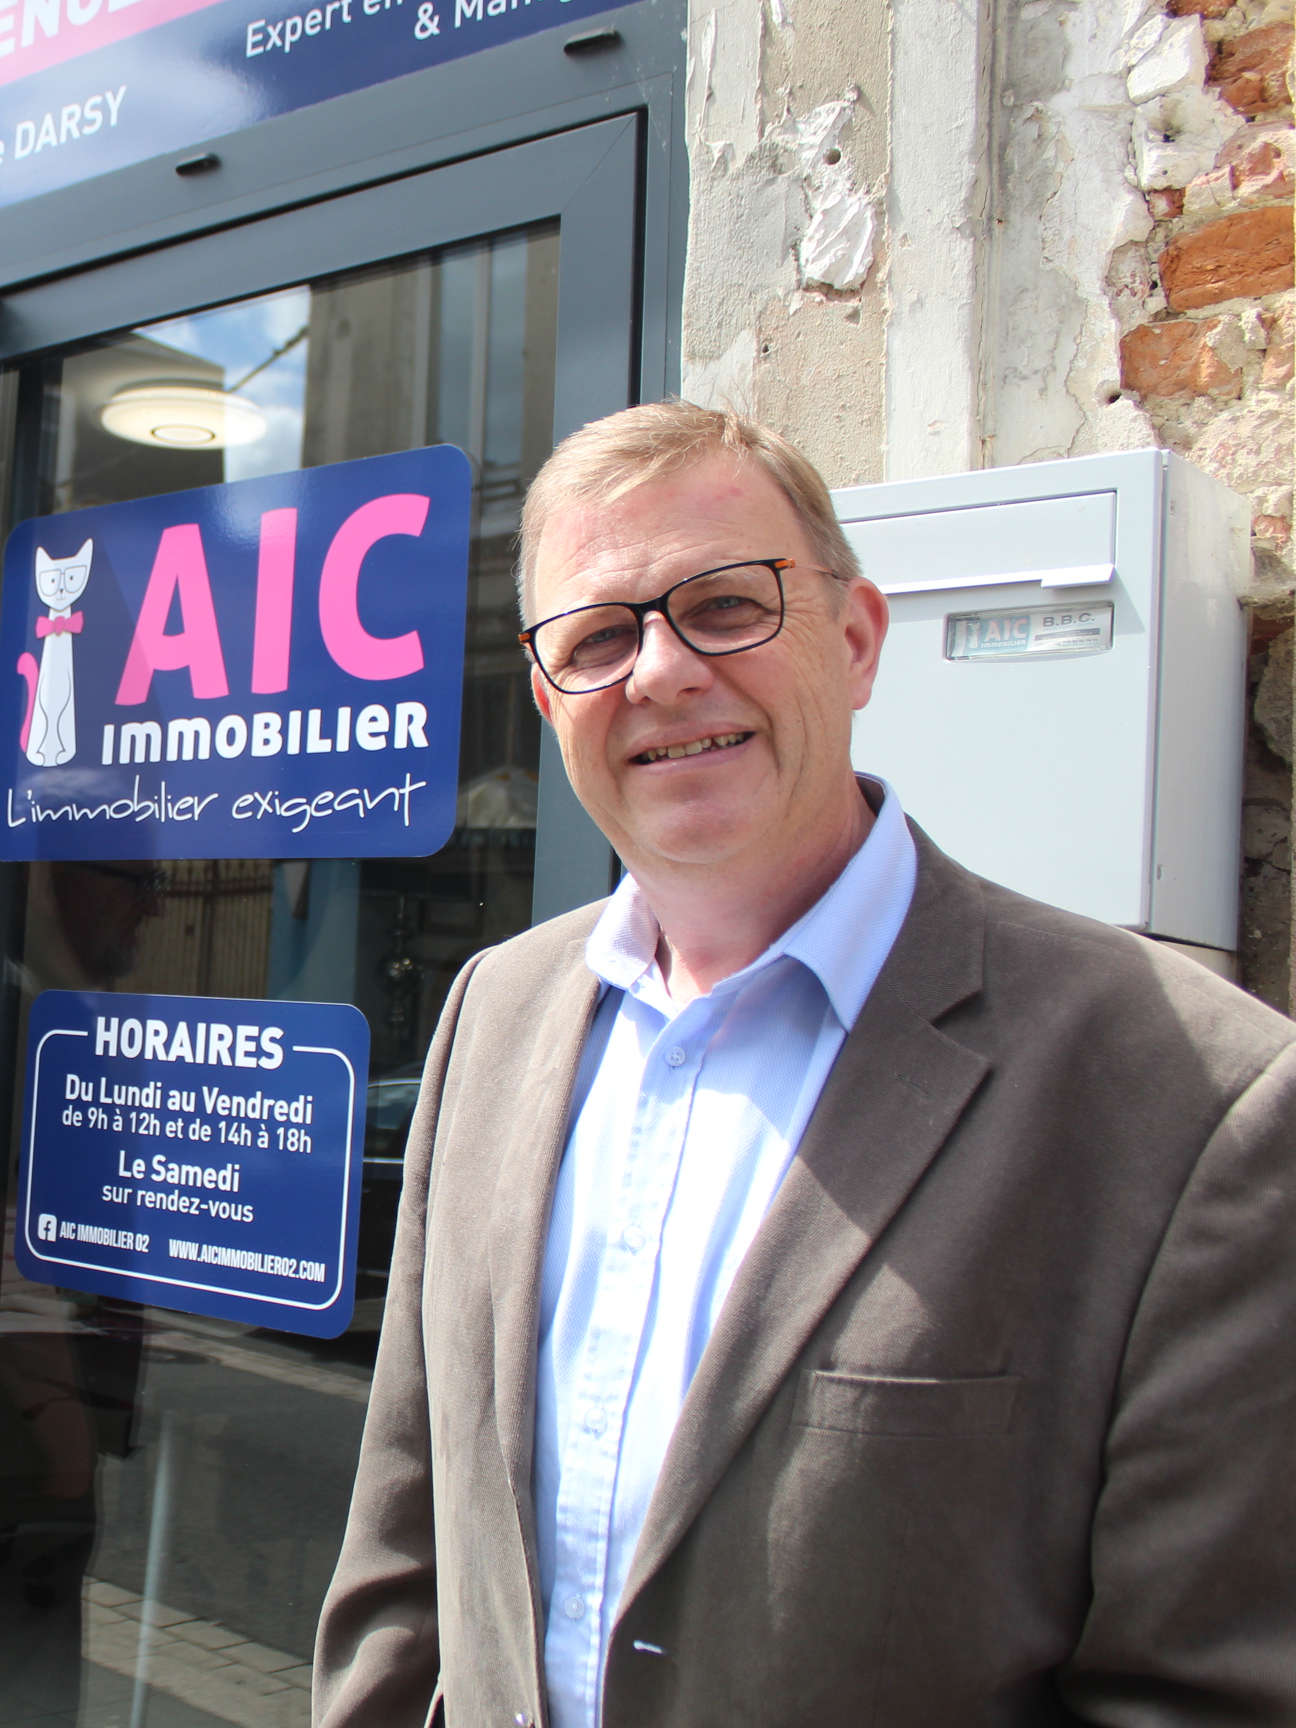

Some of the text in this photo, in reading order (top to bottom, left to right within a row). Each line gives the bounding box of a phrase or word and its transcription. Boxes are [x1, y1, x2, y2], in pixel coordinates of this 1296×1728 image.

[246, 0, 352, 58] Expert
[413, 1, 441, 41] &
[14, 85, 127, 160] DARSY
[115, 493, 431, 706] AIC
[1043, 612, 1095, 628] B.B.C.
[984, 618, 1028, 642] AIC
[7, 773, 427, 833] L'immobilier exigeant
[95, 1016, 285, 1070] HORAIRES
[65, 1074, 313, 1125] Du Lundi au Vendredi
[62, 1105, 312, 1153] de 9h à 12h et de 14h à 18h
[118, 1150, 240, 1193] Le Samedi
[102, 1184, 254, 1223] sur rendez-vous
[59, 1221, 150, 1253] AIC IMMOBILIER 02
[169, 1238, 326, 1283] WWW.AICIMMOBILIER02.COM
